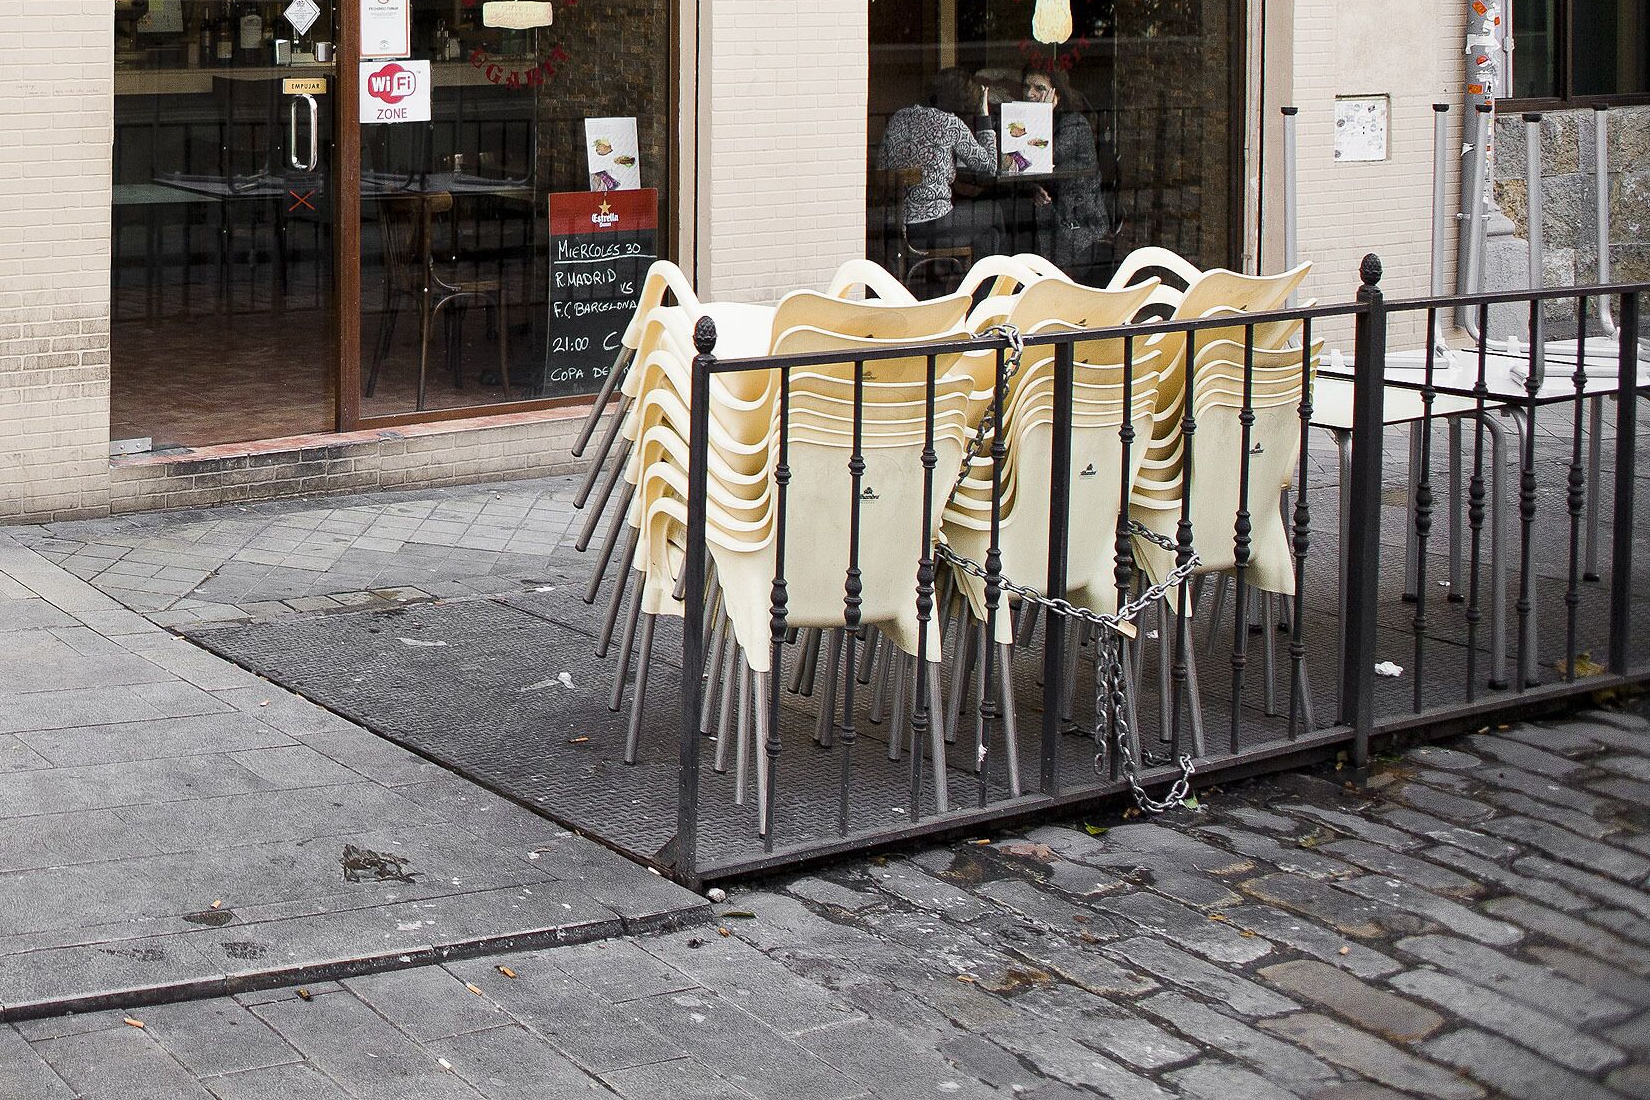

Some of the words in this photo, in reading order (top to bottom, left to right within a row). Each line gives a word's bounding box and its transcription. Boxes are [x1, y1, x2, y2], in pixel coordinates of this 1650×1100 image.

[291, 82, 320, 90] EMPUJAR
[376, 108, 408, 120] ZONE
[592, 213, 619, 223] Estrella
[558, 241, 620, 260] MIERCOLES
[626, 243, 640, 254] 30
[552, 337, 589, 353] 21:00
[550, 366, 584, 381] COPA
